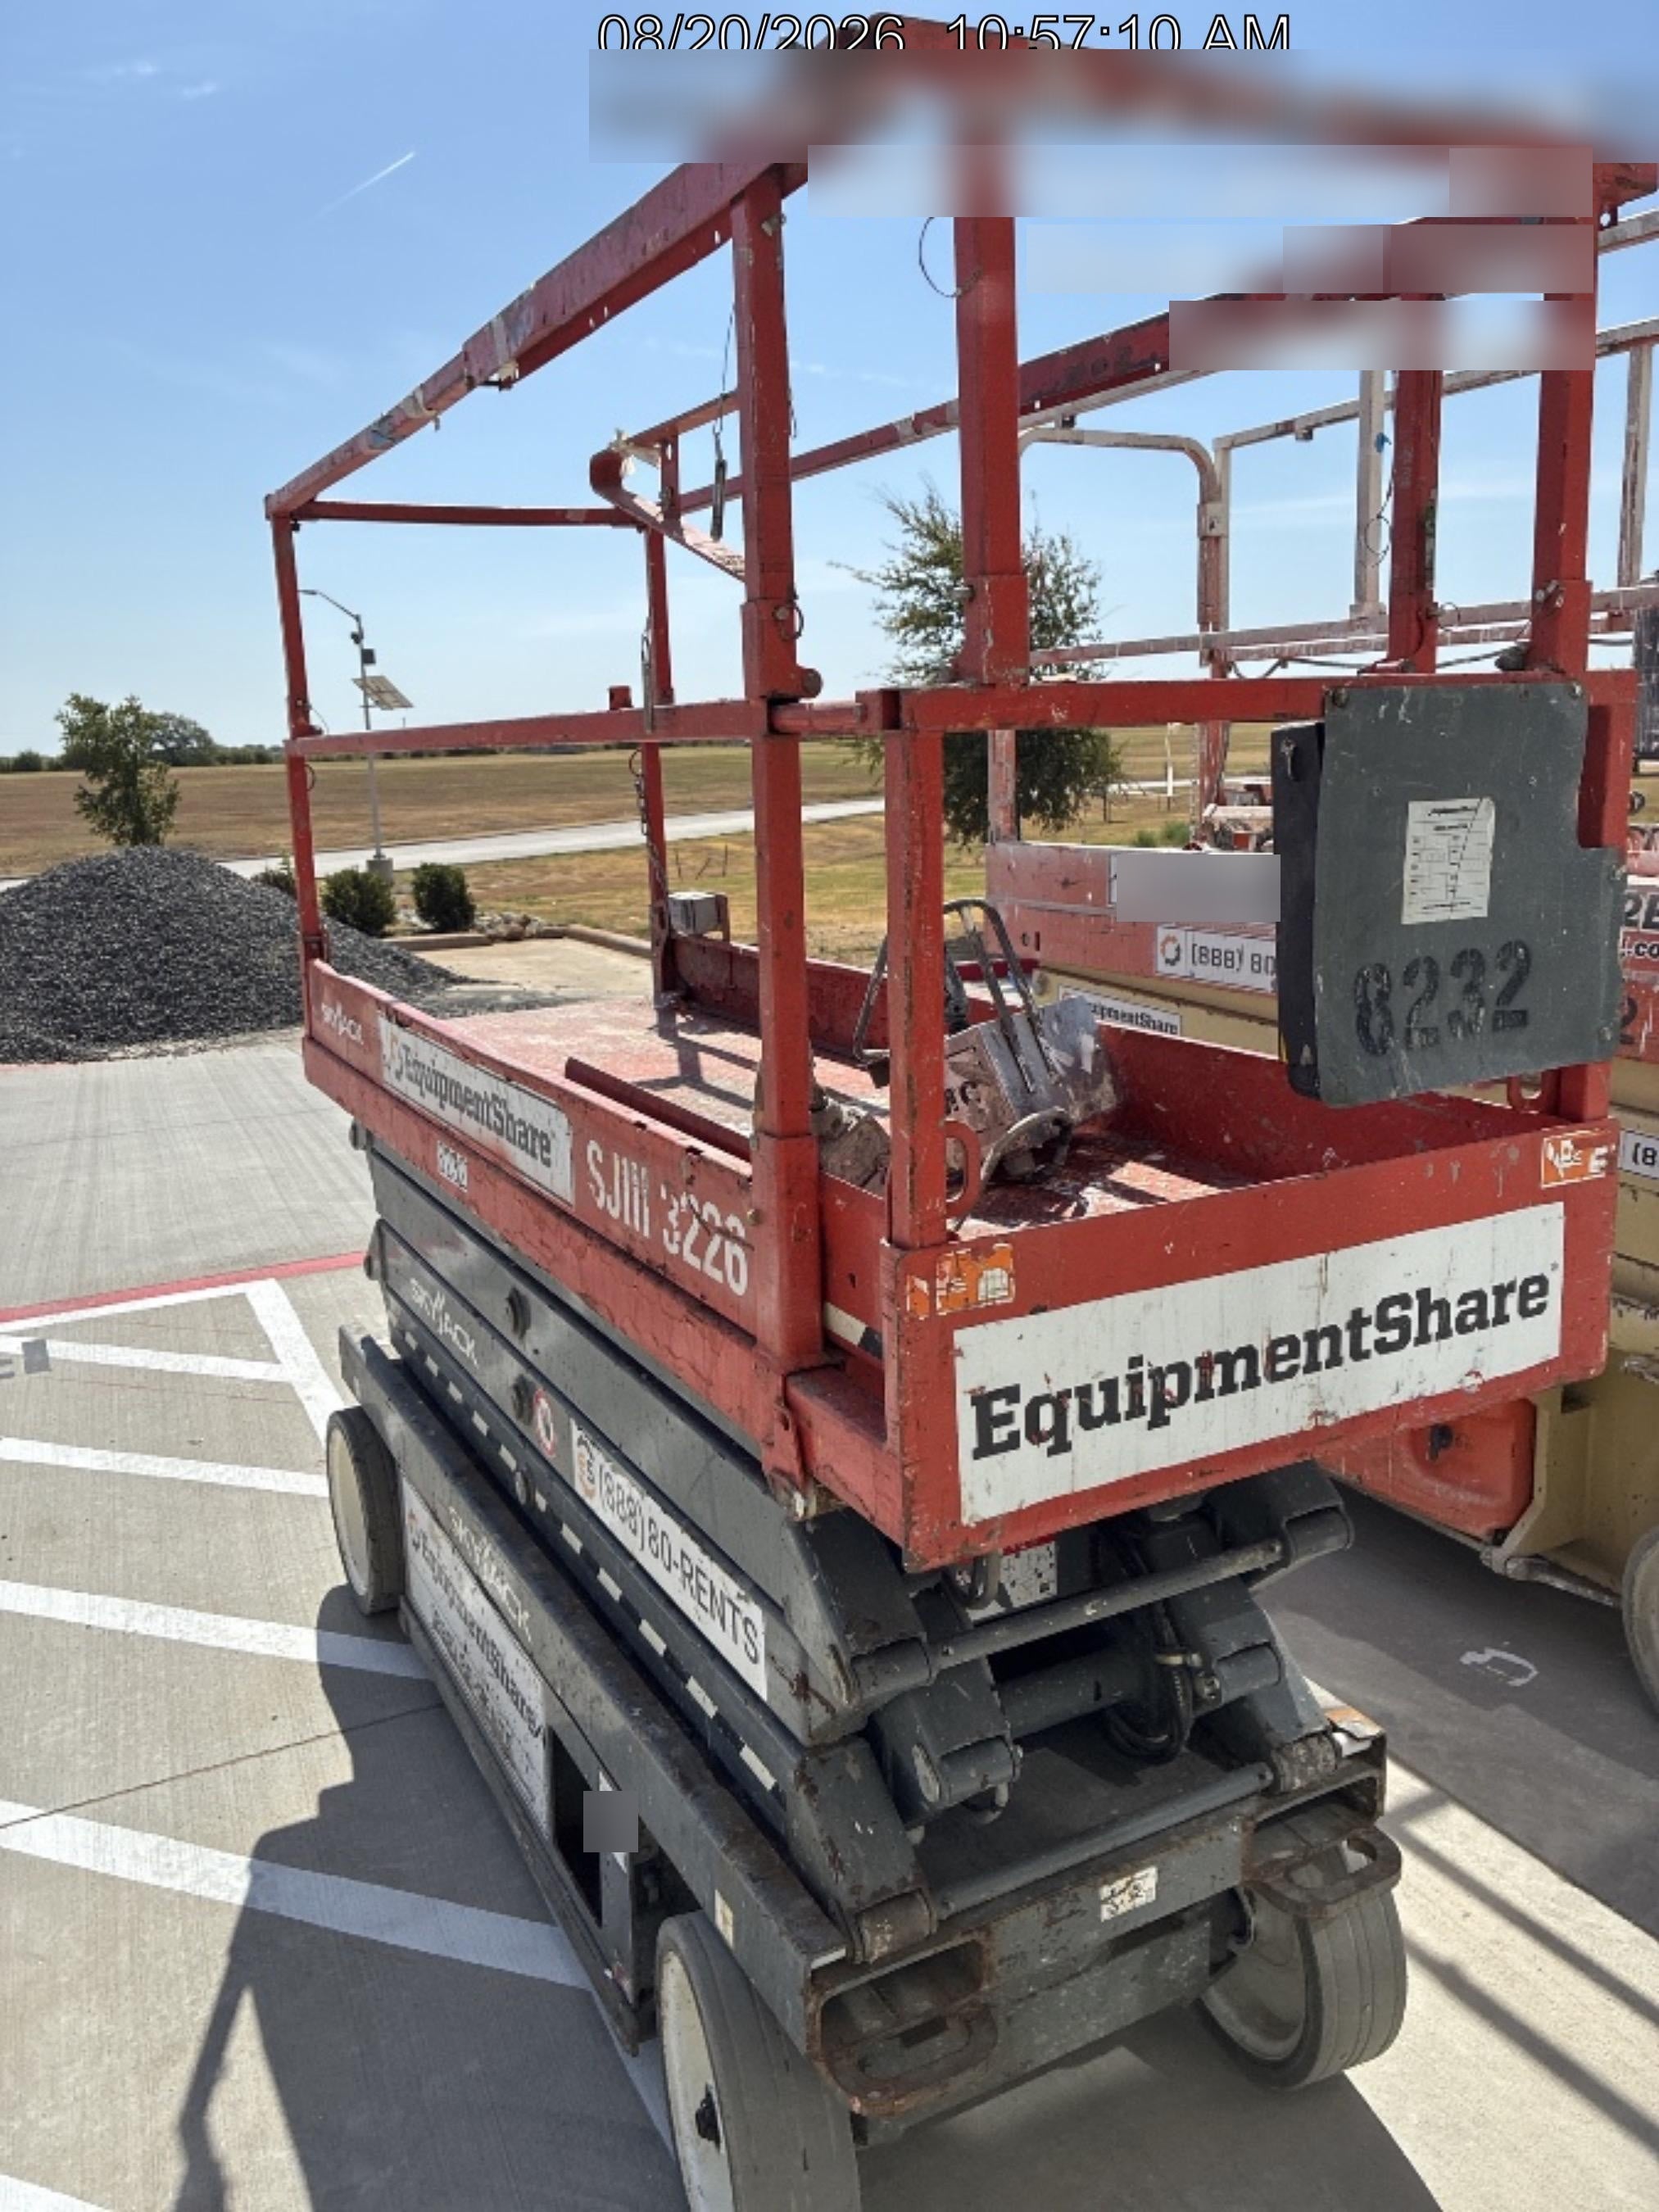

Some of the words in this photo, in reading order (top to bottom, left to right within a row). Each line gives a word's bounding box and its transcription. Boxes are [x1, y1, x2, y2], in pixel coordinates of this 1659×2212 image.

[1192, 941, 1244, 972] (888)
[1353, 940, 1532, 1057] 8232
[660, 1182, 749, 1297] 3226
[972, 1273, 1550, 1457] EquipmentShare
[648, 1516, 759, 1666] 80-RENTS
